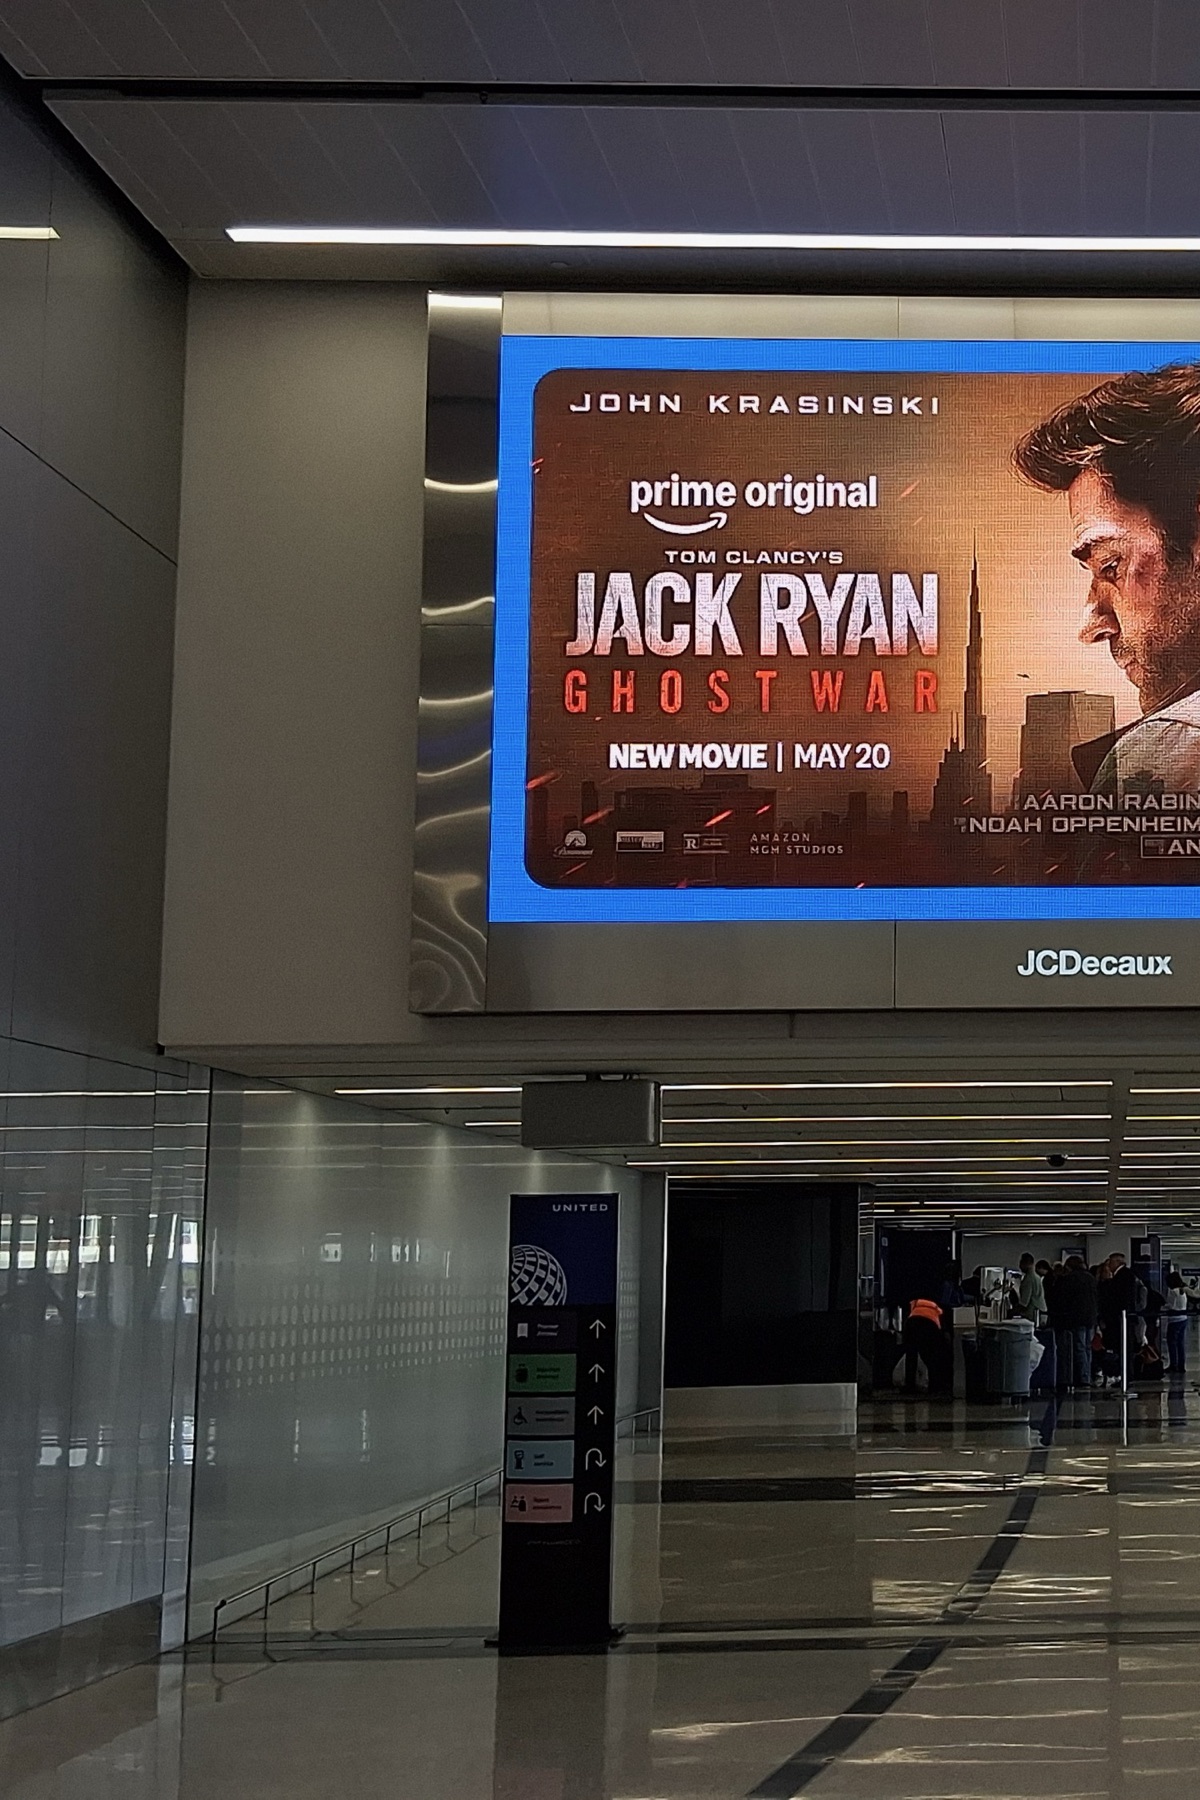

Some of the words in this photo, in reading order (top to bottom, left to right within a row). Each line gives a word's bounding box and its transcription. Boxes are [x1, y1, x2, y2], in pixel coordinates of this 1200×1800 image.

[570, 394, 681, 413] JOHN
[709, 395, 940, 415] KRASINSKI
[630, 473, 737, 513] prime
[745, 474, 877, 514] original
[665, 551, 716, 564] TOM
[726, 551, 843, 565] CLANCY'S
[565, 572, 743, 656] JACK
[760, 573, 939, 656] RYAN
[563, 669, 778, 714] GHOST
[811, 670, 938, 714] WAR
[609, 743, 676, 770] NEW
[679, 743, 768, 769] MOVIE
[794, 743, 849, 769] MAY
[854, 743, 891, 769] 20
[1022, 794, 1120, 811] AARON
[969, 816, 1042, 833] NOAH
[750, 833, 810, 843] AMAZON
[750, 845, 780, 855] MGM
[786, 845, 844, 855] STUDIOS
[1017, 949, 1173, 977] JCDecaux
[552, 1203, 608, 1212] UNITED
